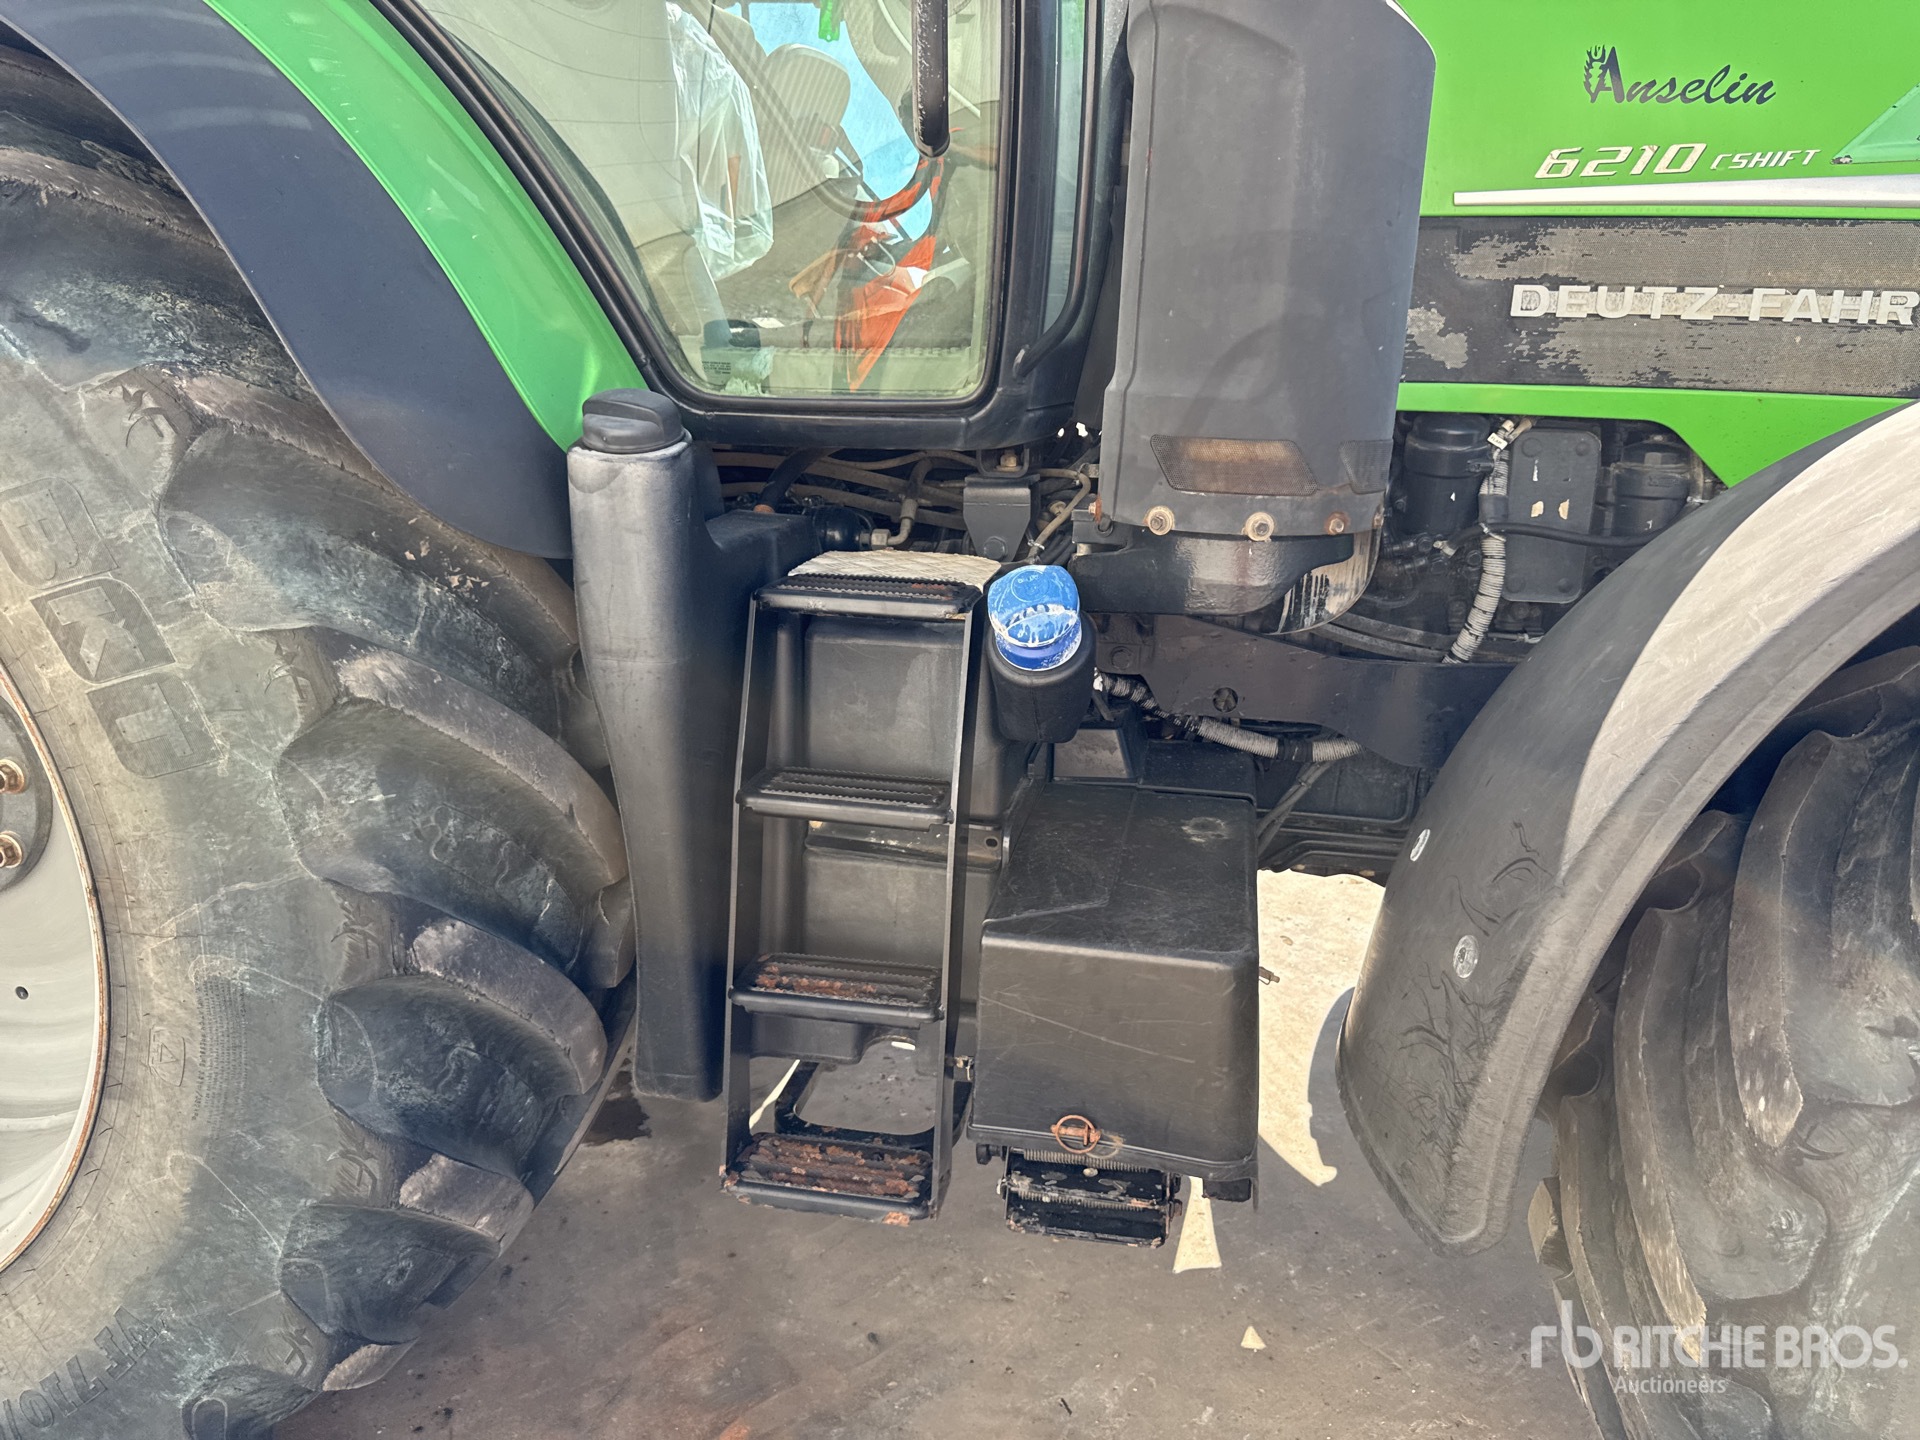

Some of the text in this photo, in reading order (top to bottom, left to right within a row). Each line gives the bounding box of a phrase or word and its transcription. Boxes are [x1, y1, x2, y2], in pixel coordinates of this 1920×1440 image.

[1584, 45, 1776, 104] Anselin
[1535, 143, 1707, 179] 6210
[1510, 284, 1920, 325] DEUTZ-FAHR
[0, 485, 196, 758] BKT
